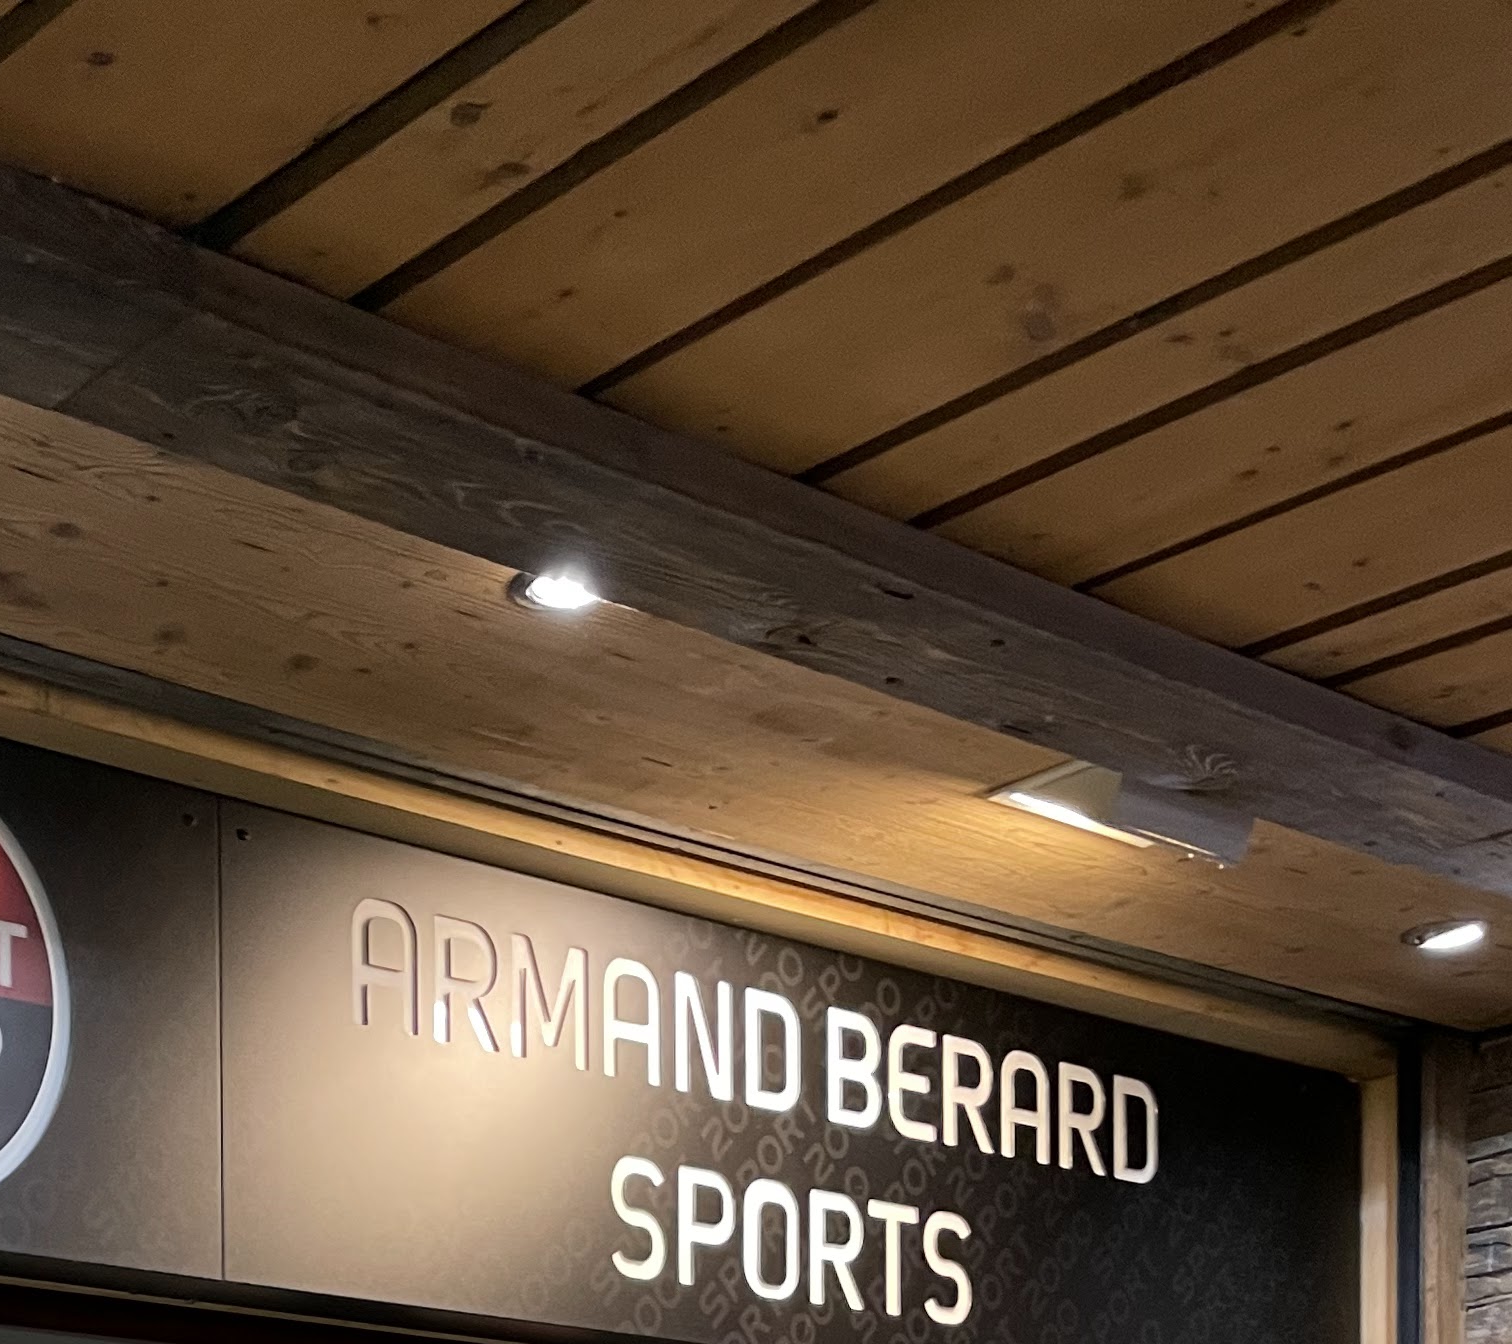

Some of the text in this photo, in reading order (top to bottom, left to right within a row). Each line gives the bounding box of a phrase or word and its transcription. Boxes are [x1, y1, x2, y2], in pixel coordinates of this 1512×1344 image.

[350, 897, 1161, 1186] ARMAND BERARD
[609, 1154, 974, 1328] SPORTS
